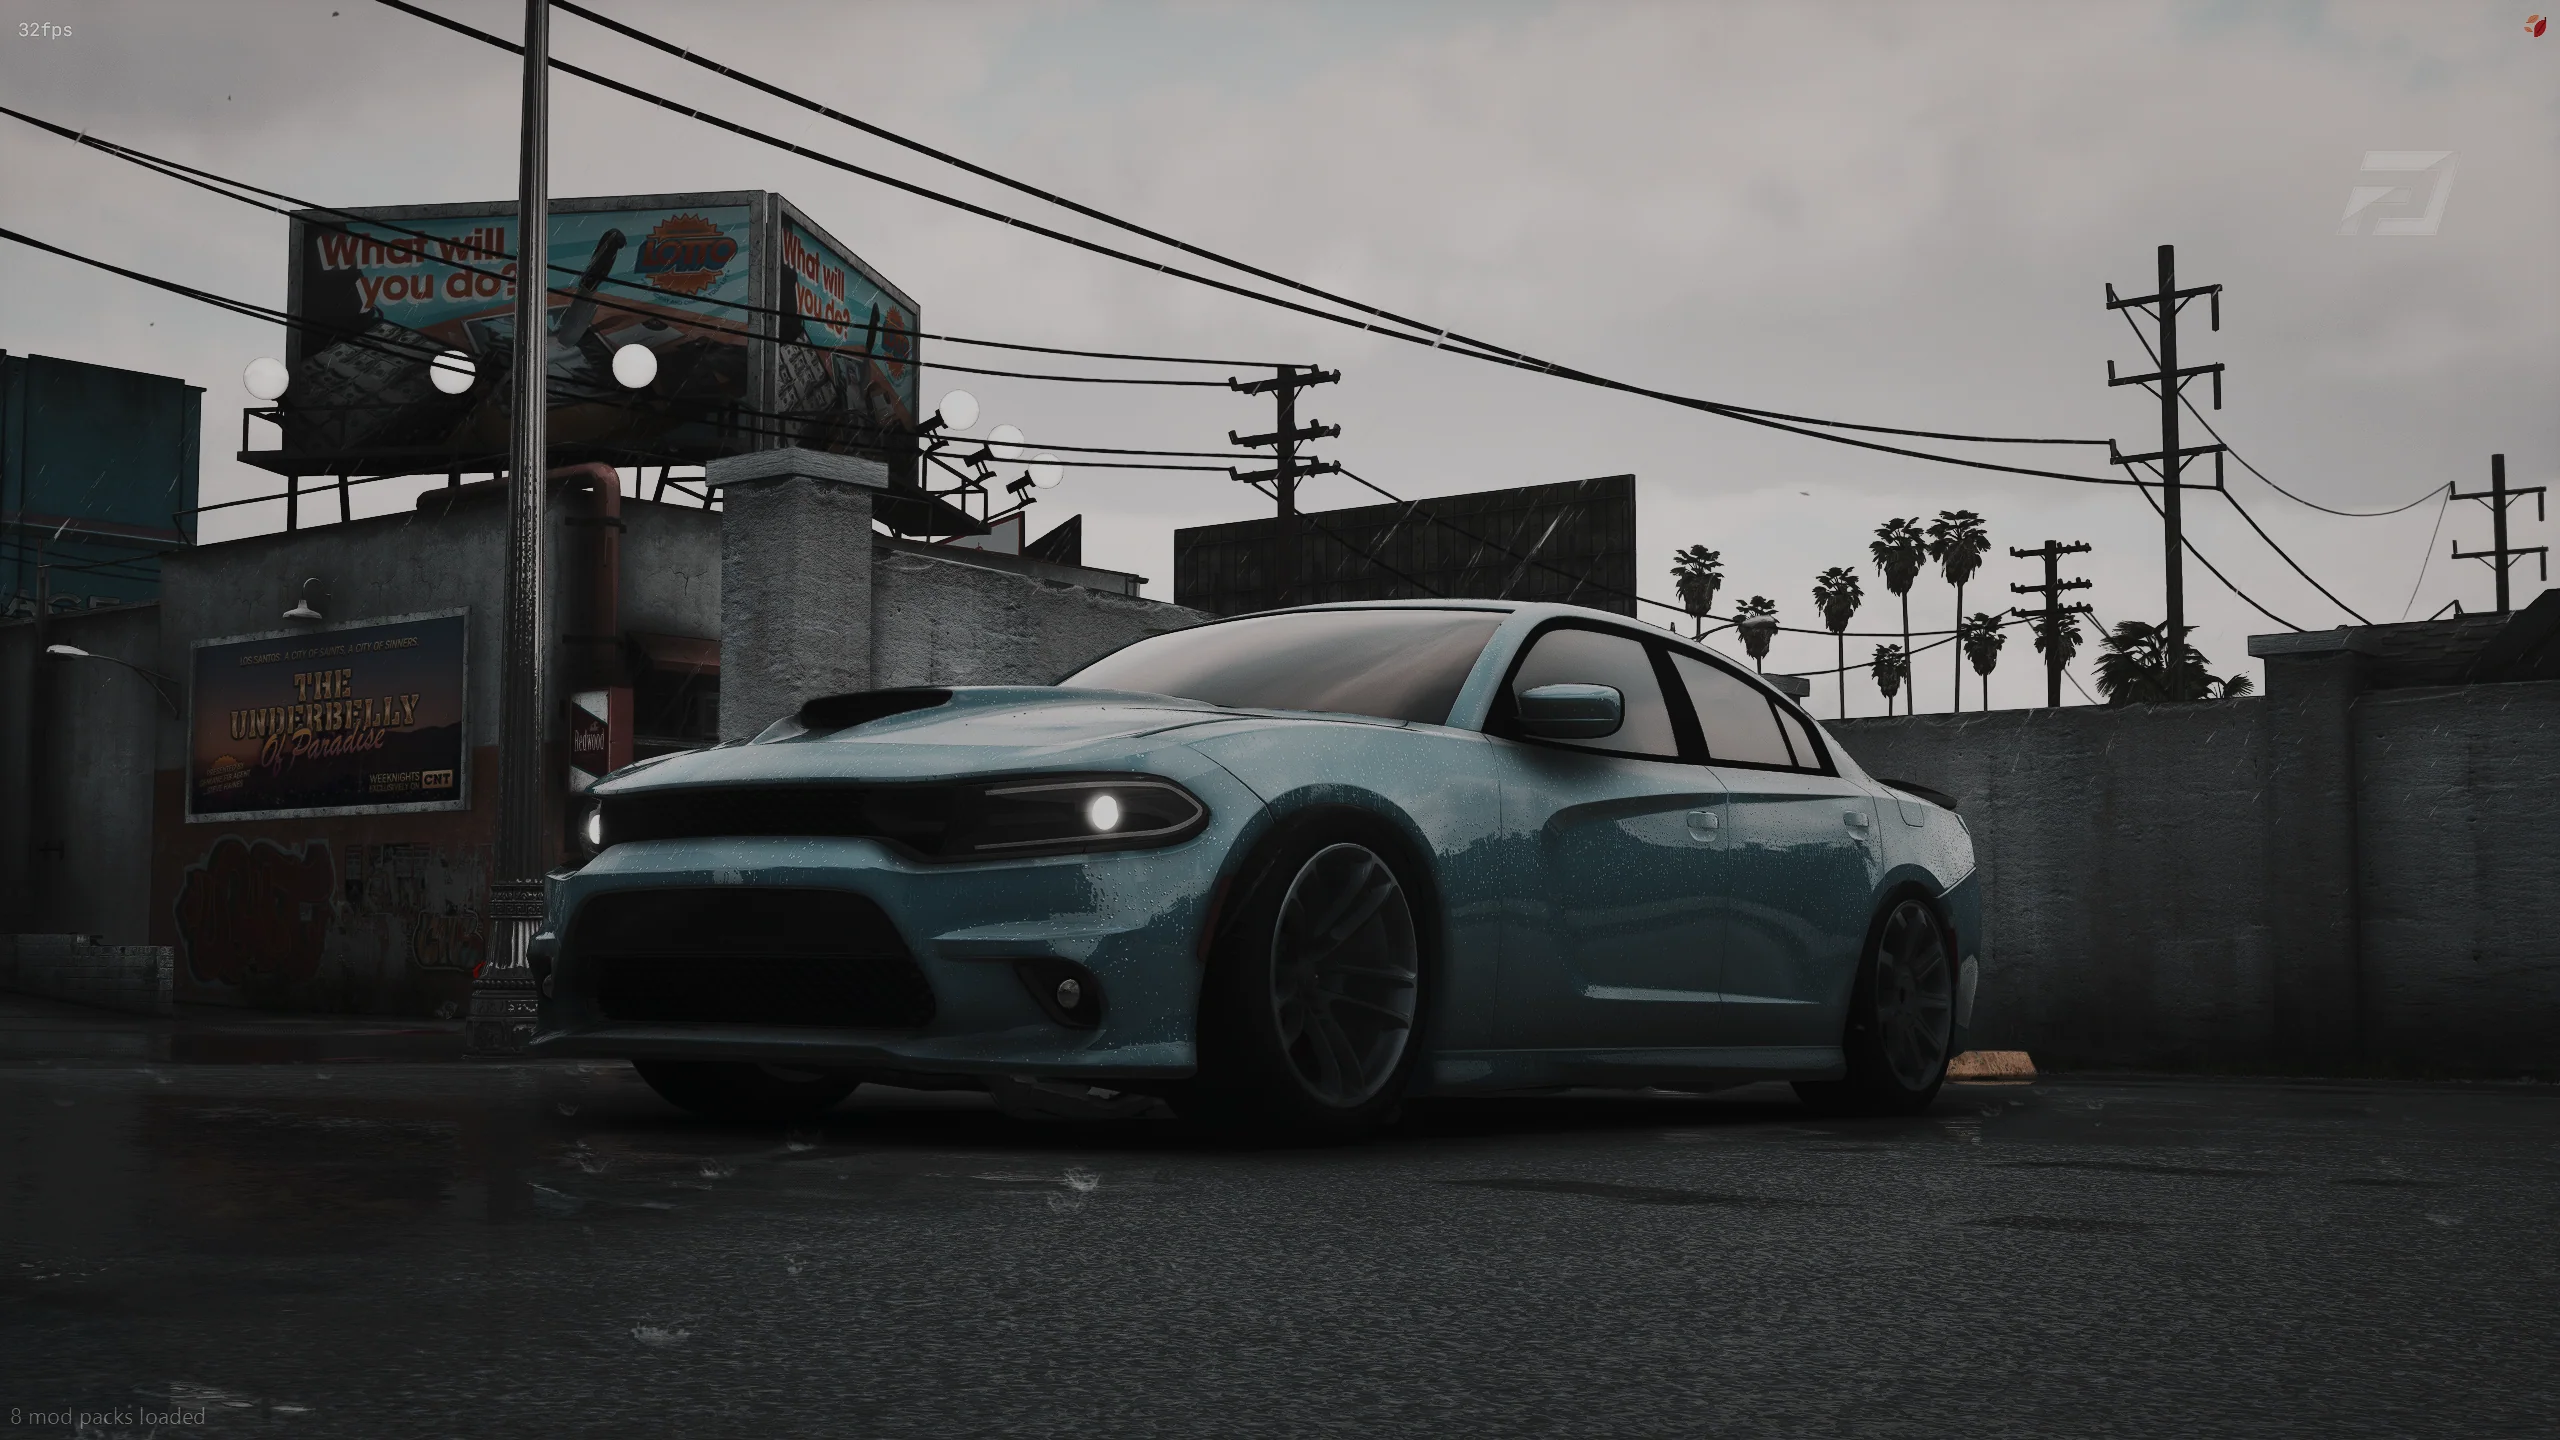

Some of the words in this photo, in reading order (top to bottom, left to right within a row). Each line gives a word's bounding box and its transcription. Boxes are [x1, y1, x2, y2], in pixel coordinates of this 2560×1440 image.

[317, 229, 428, 271] What
[436, 227, 506, 266] will
[642, 239, 738, 267] LOTTO
[782, 227, 820, 286] What
[823, 263, 845, 303] will
[356, 273, 434, 313] you
[795, 281, 822, 319] you
[824, 299, 851, 342] do?
[240, 656, 252, 666] LOS
[284, 652, 289, 660] A
[292, 649, 308, 660] CITY
[308, 648, 319, 657] OF
[355, 642, 372, 653] CITY
[373, 640, 384, 651] OF
[385, 636, 419, 649] SINNERS.
[293, 667, 352, 702] THE
[230, 693, 420, 741] UNDERBELLY
[261, 732, 287, 778] Of
[287, 719, 386, 772] Paradise
[574, 728, 605, 752] Redwood
[368, 783, 409, 794] EXCLUSIVELY
[411, 782, 420, 791] ON
[369, 772, 420, 784] WEEKNIGHTS
[423, 773, 451, 785] CNT
